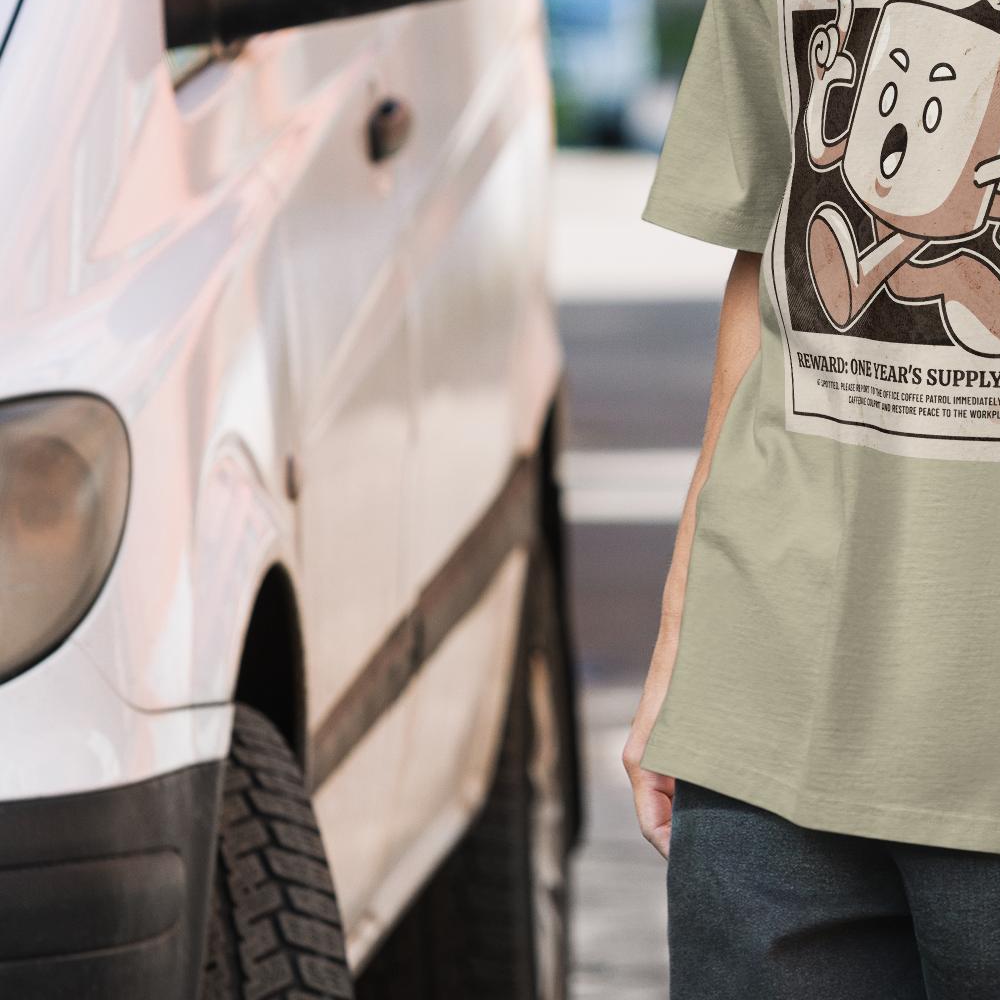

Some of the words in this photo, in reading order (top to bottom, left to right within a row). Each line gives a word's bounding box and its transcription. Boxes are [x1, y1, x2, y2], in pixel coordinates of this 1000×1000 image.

[797, 351, 848, 374] REWARD:
[850, 358, 872, 377] ONE
[873, 362, 922, 385] YEAR'S
[840, 382, 856, 391] PLEASE
[856, 383, 870, 393] REPORT
[874, 387, 882, 398] THE
[882, 389, 900, 401] OFFICE
[901, 392, 924, 403] COFFEE
[925, 394, 951, 405] PATROL
[848, 395, 866, 406] CAFFEINE
[881, 402, 891, 412] AND
[891, 404, 917, 415] RESTORE
[918, 406, 940, 417] PEACE
[942, 408, 951, 418] TO
[953, 409, 967, 418] THE
